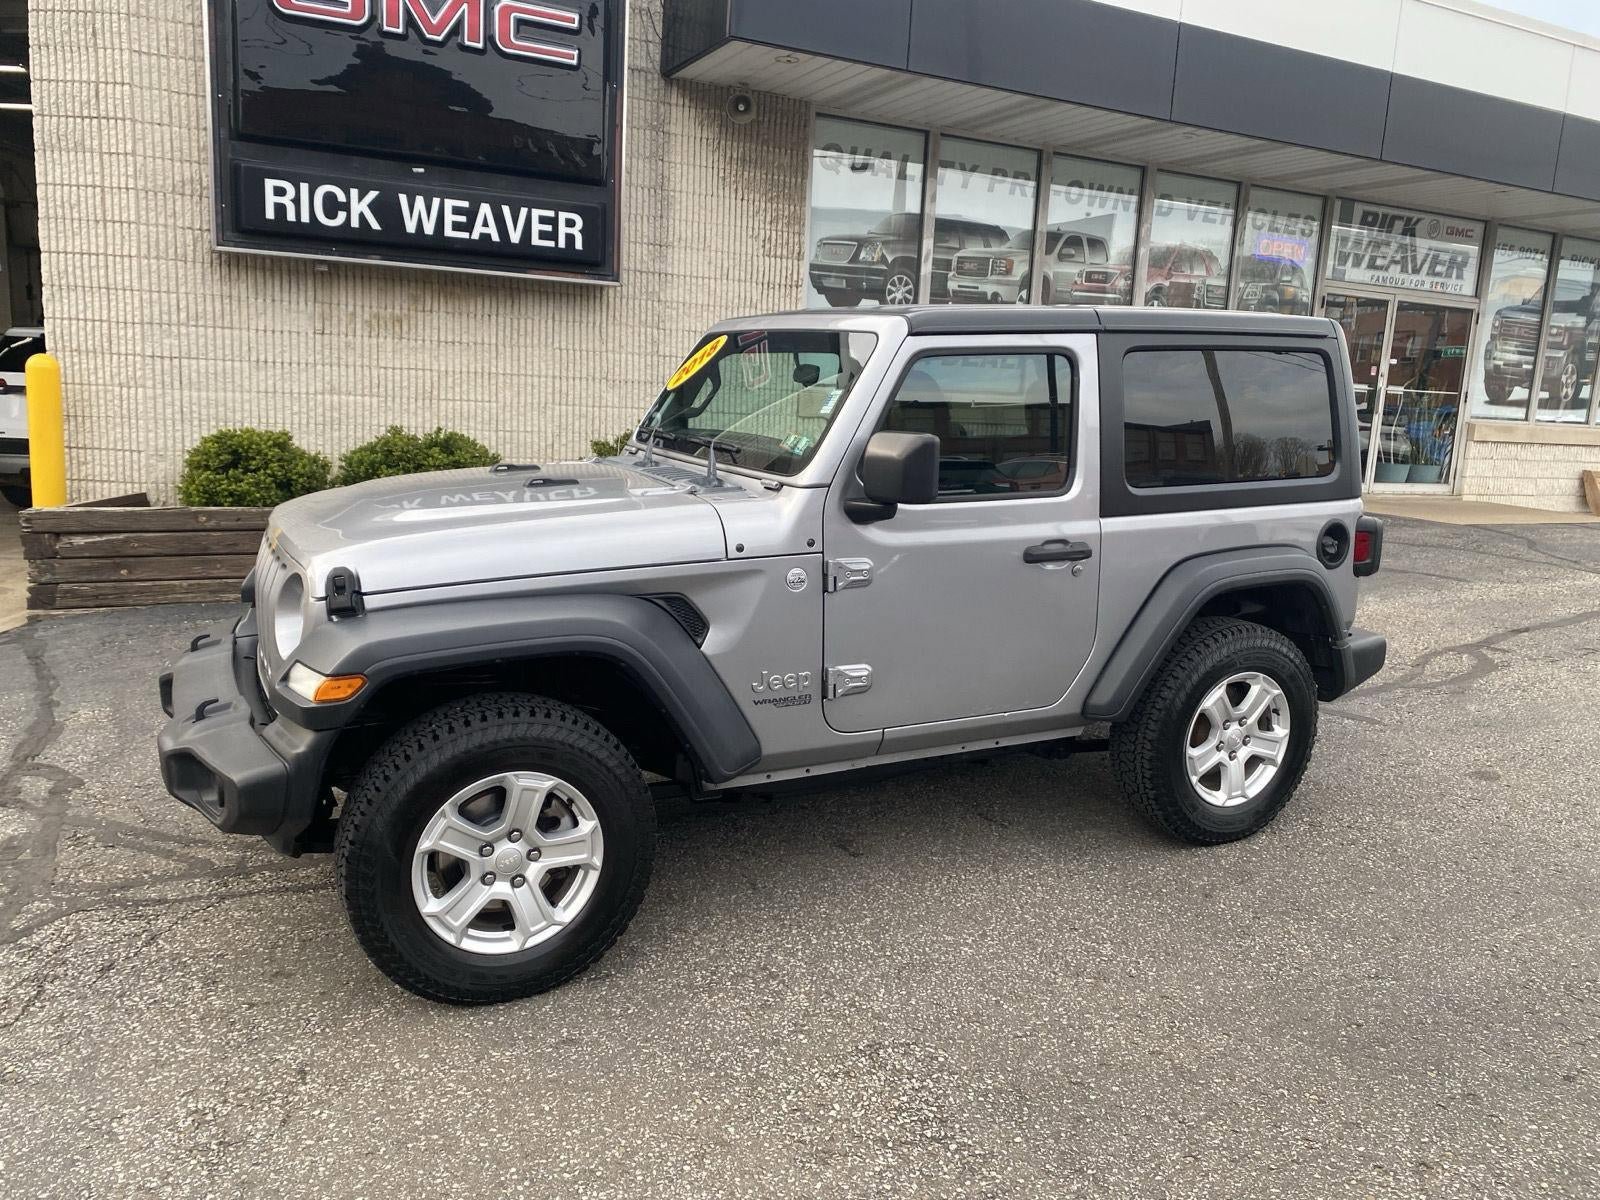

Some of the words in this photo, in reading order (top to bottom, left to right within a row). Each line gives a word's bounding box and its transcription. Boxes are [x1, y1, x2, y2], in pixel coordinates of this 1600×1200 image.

[819, 143, 980, 189] QUALTY
[264, 178, 381, 231] RICK
[398, 193, 583, 250] WEAVER
[1359, 210, 1425, 238] RICK
[1445, 225, 1474, 239] GMC
[1259, 239, 1305, 261] OPEN
[1337, 235, 1470, 280] WEAVER
[1370, 274, 1405, 286] FAMOUS
[1409, 279, 1425, 289] FOR
[1429, 281, 1464, 292] SERVICE
[752, 670, 811, 693] Jeep
[752, 693, 813, 706] WRANGLER
